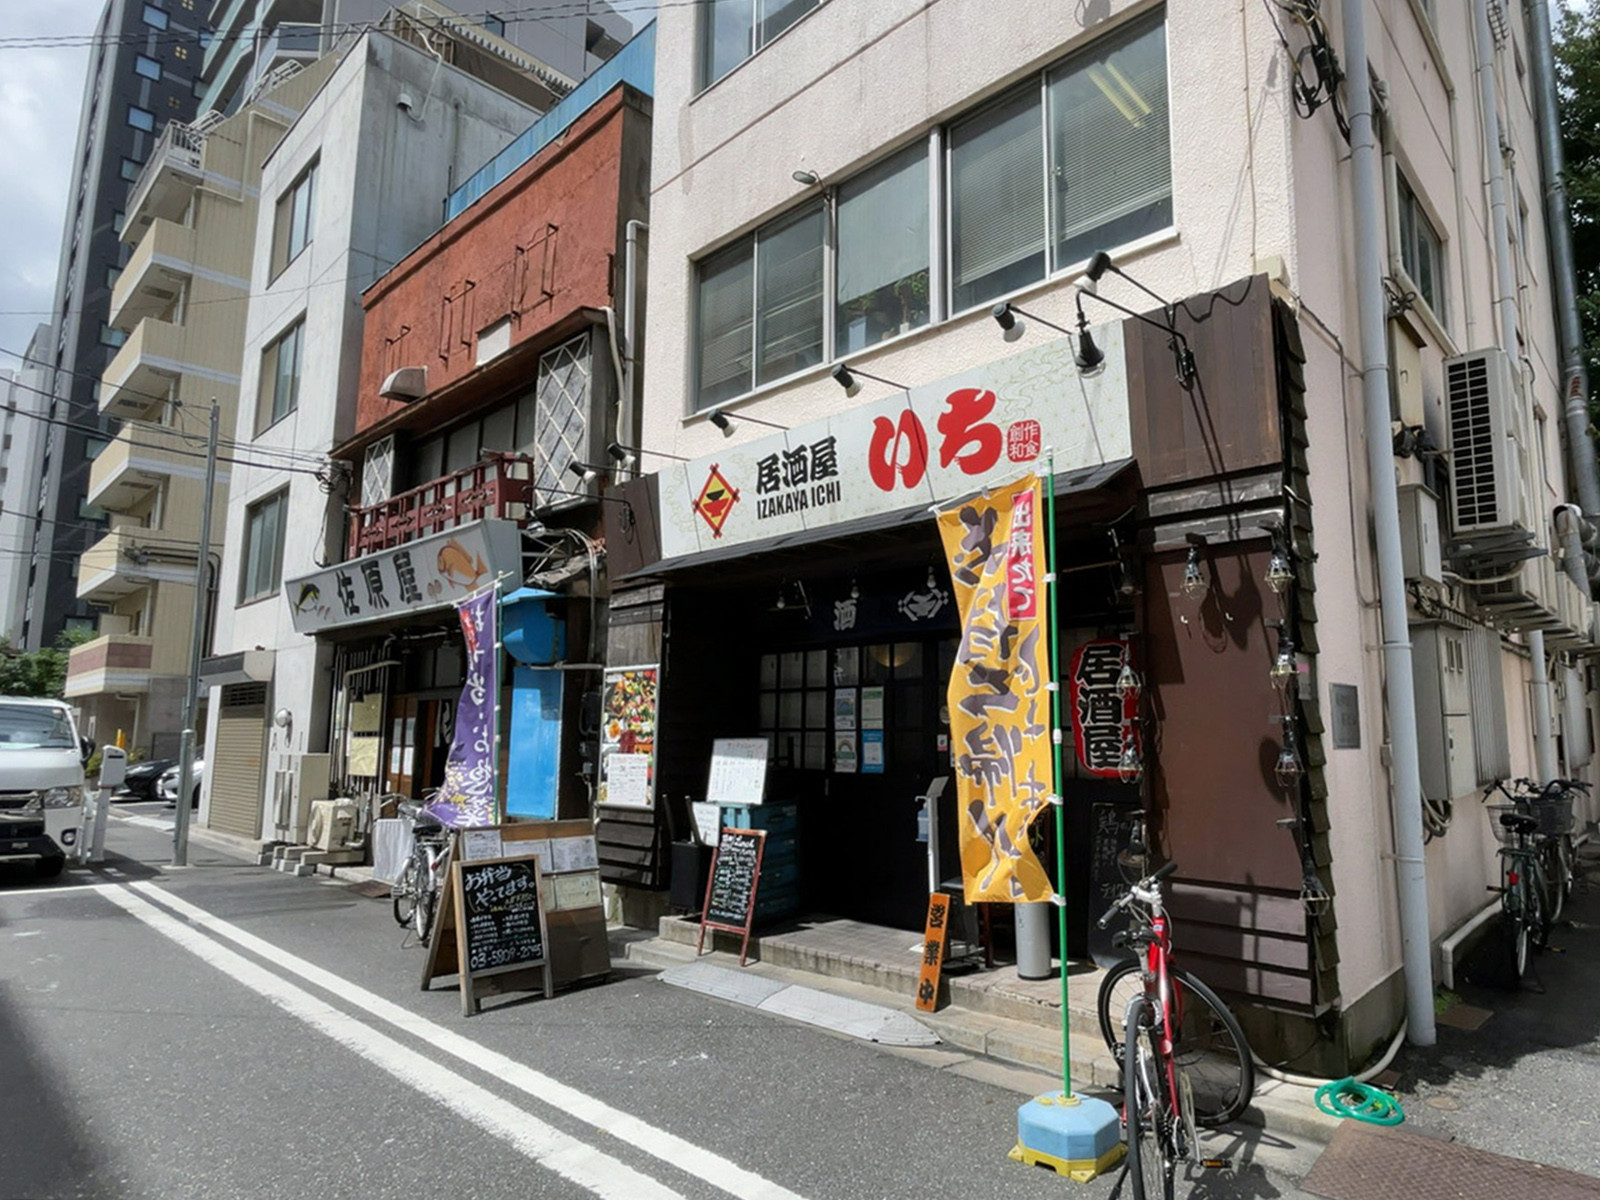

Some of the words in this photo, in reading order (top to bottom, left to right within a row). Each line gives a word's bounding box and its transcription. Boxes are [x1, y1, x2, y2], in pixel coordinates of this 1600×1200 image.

[756, 436, 838, 495] 居酒屋
[868, 388, 1002, 492] いち
[757, 489, 808, 520] IZAKAYA
[809, 483, 841, 508] ICHI
[336, 550, 423, 617] 佐原屋
[833, 598, 858, 631] 酒
[1077, 644, 1125, 769] 居酒屋
[918, 903, 946, 1005] 営業中
